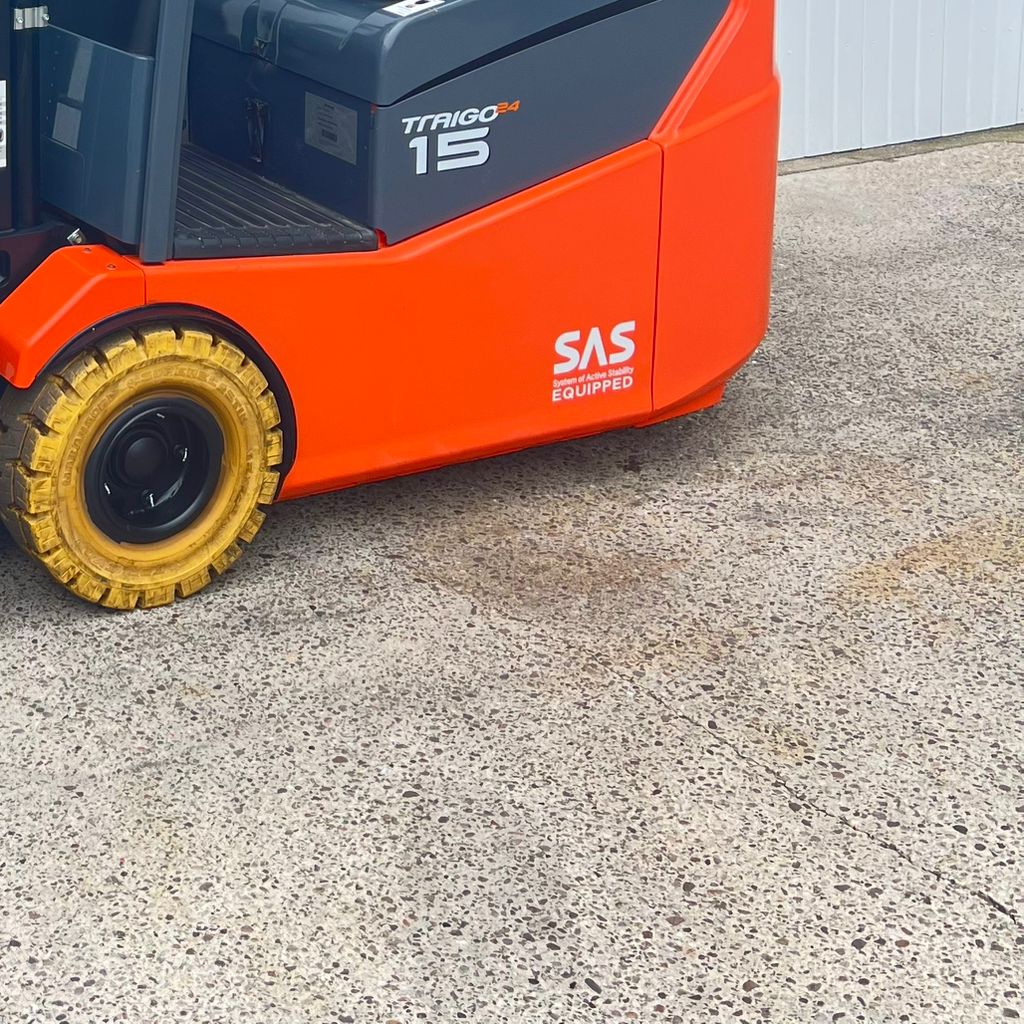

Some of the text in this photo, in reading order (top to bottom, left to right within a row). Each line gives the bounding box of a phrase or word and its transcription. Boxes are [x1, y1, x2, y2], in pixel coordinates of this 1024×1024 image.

[408, 126, 490, 175] 15
[553, 320, 636, 375] SAS
[552, 376, 633, 402] EQUIPPED
[553, 366, 634, 388] System of Active Stability
